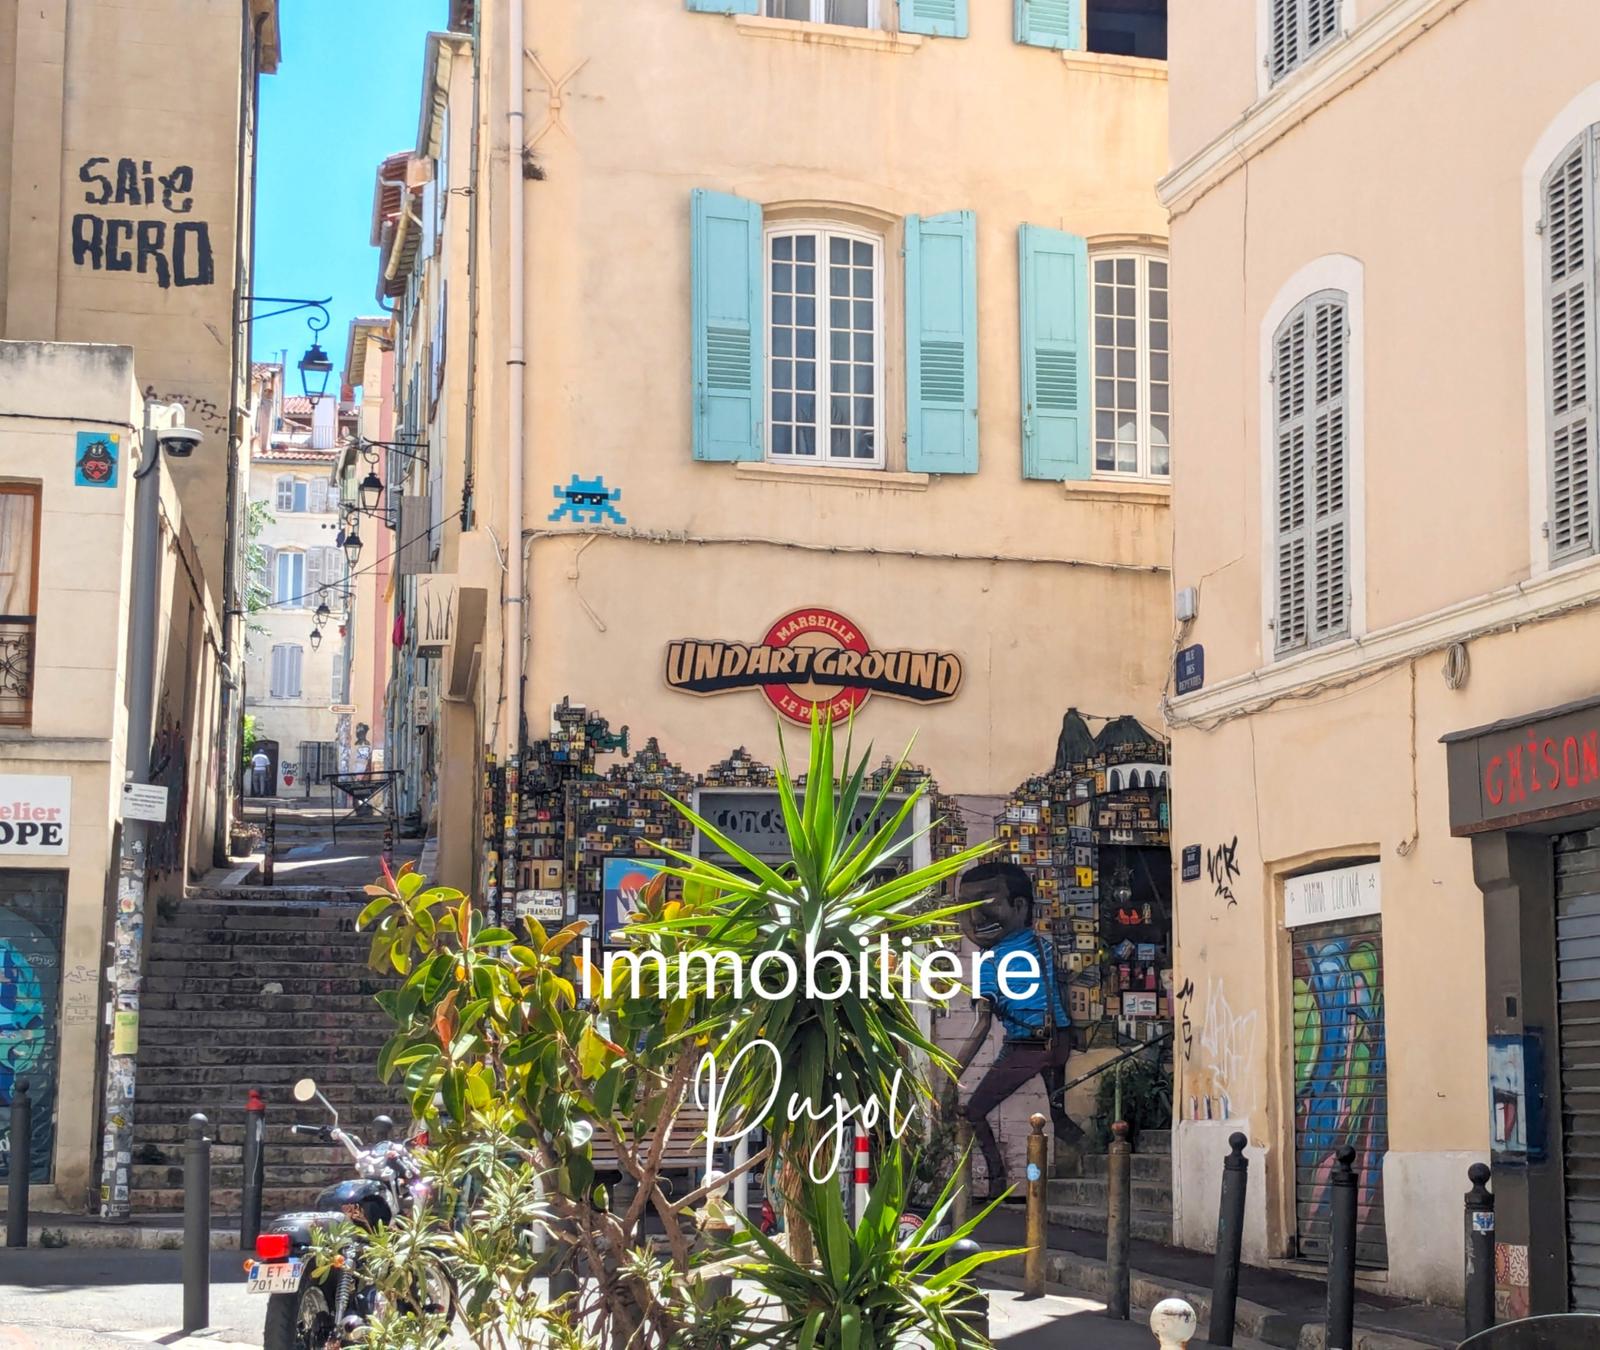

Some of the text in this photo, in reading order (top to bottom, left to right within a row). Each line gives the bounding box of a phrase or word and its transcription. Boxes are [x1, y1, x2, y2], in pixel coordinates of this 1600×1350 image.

[775, 614, 855, 644] MARSEILLE
[667, 641, 963, 697] UNDARTGROUND
[779, 694, 799, 713] LE
